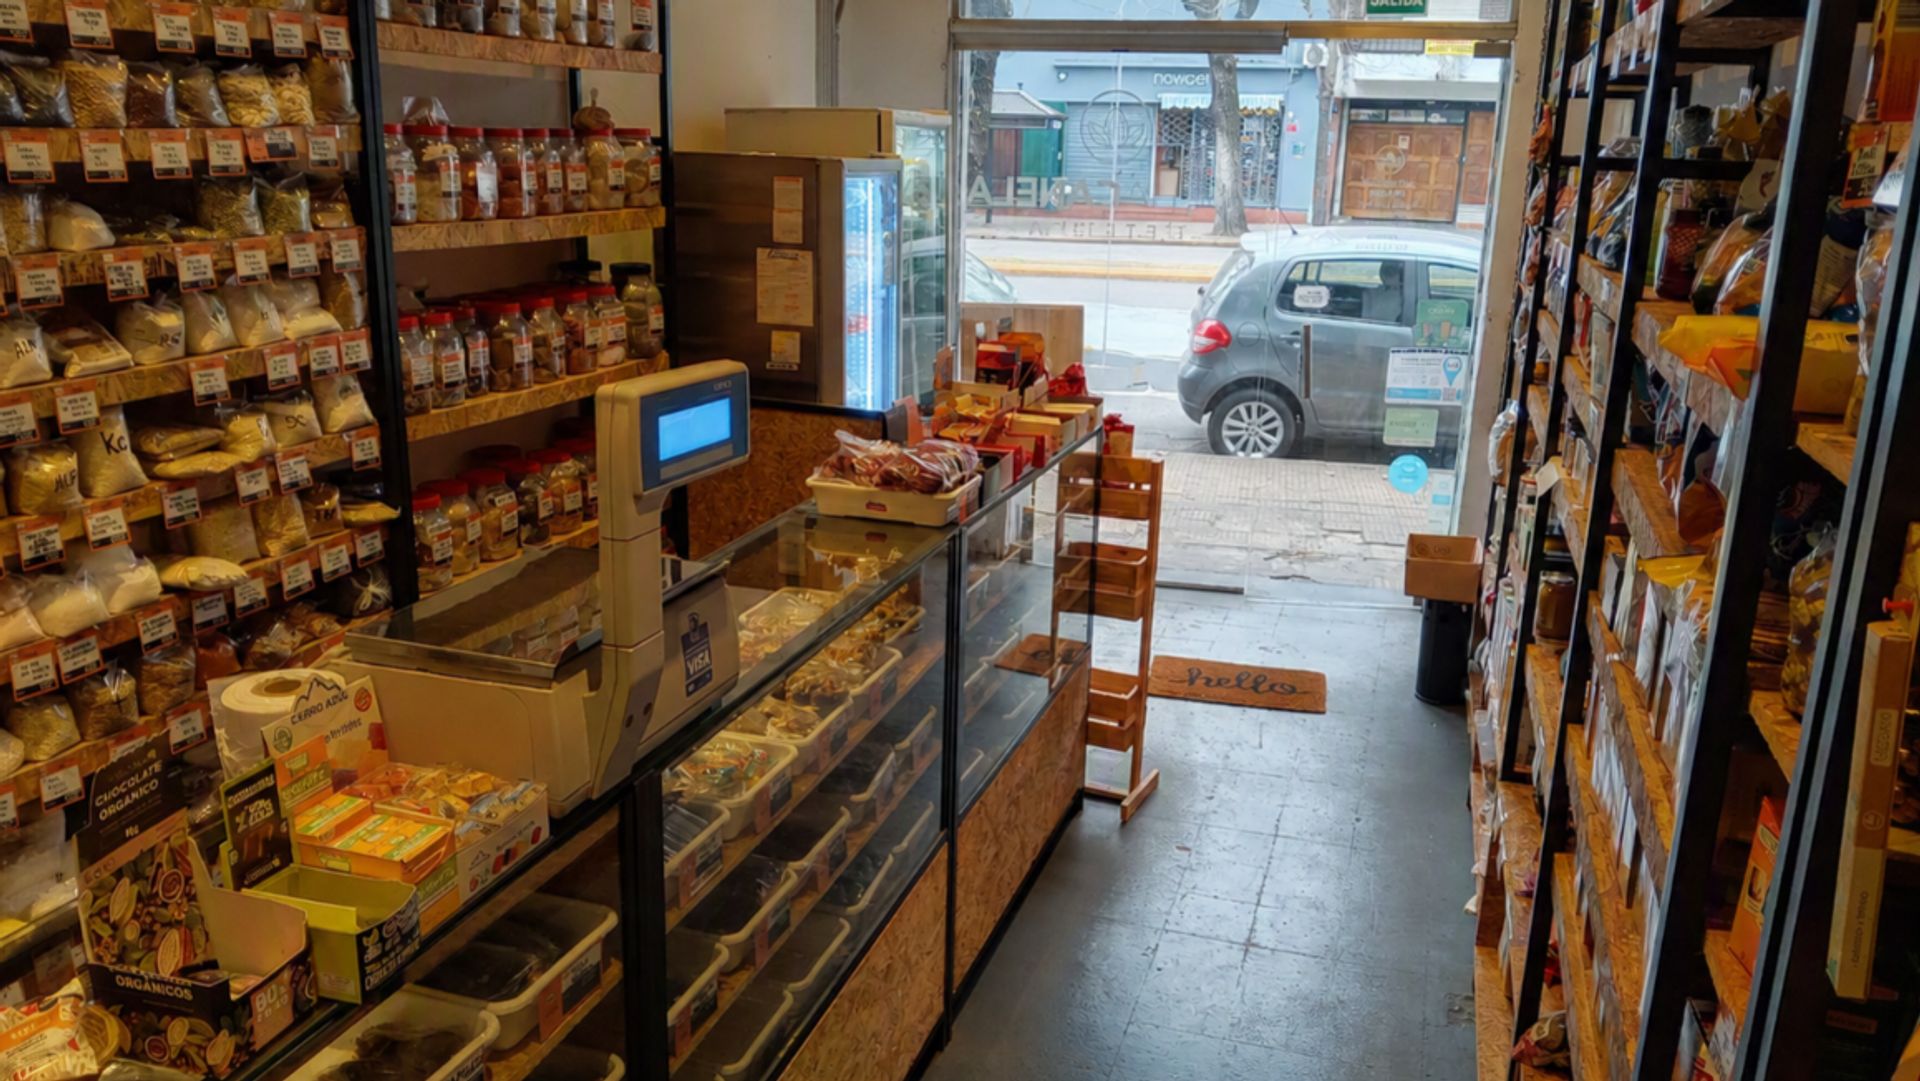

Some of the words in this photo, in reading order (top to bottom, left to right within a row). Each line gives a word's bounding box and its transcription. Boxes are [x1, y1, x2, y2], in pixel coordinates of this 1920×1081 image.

[686, 648, 711, 677] VISA
[1169, 667, 1311, 695] hello
[95, 759, 162, 807] CHOCOLATE
